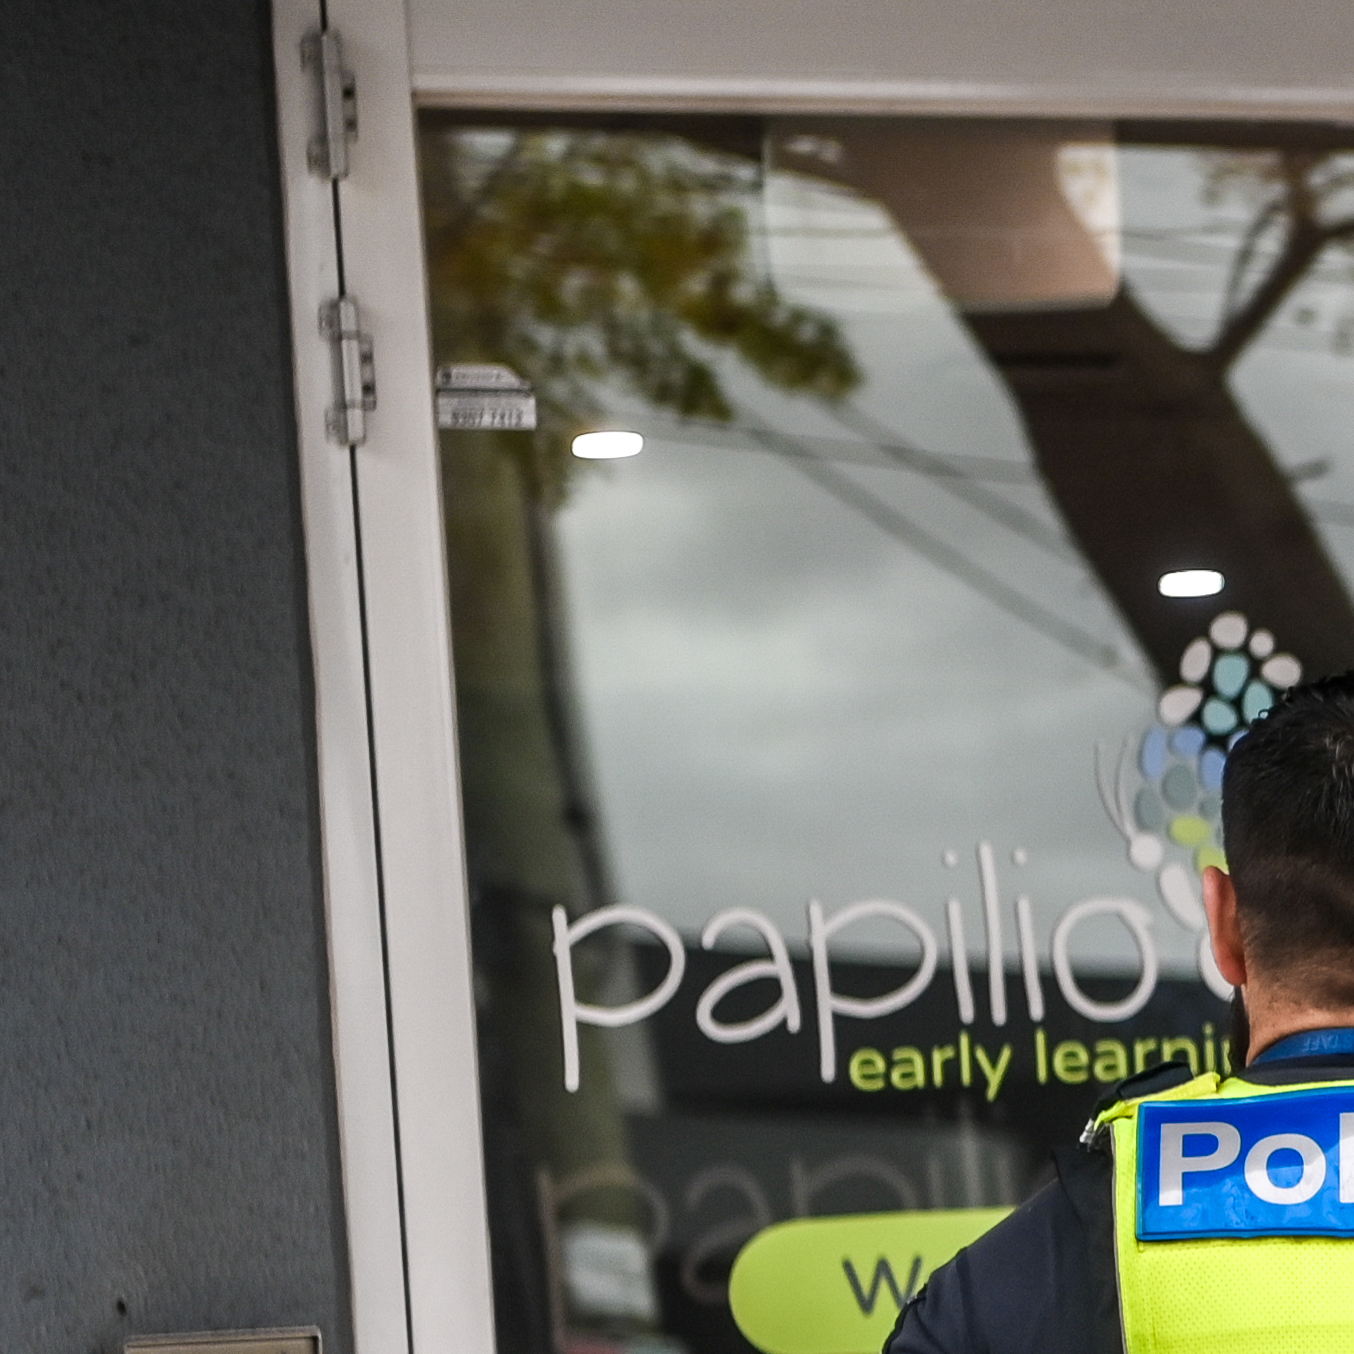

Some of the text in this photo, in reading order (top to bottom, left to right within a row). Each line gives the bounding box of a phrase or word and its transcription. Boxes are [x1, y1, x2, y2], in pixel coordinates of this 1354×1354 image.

[553, 841, 1160, 1094] papilio
[848, 1023, 1232, 1102] early learni
[841, 1254, 923, 1317] W
